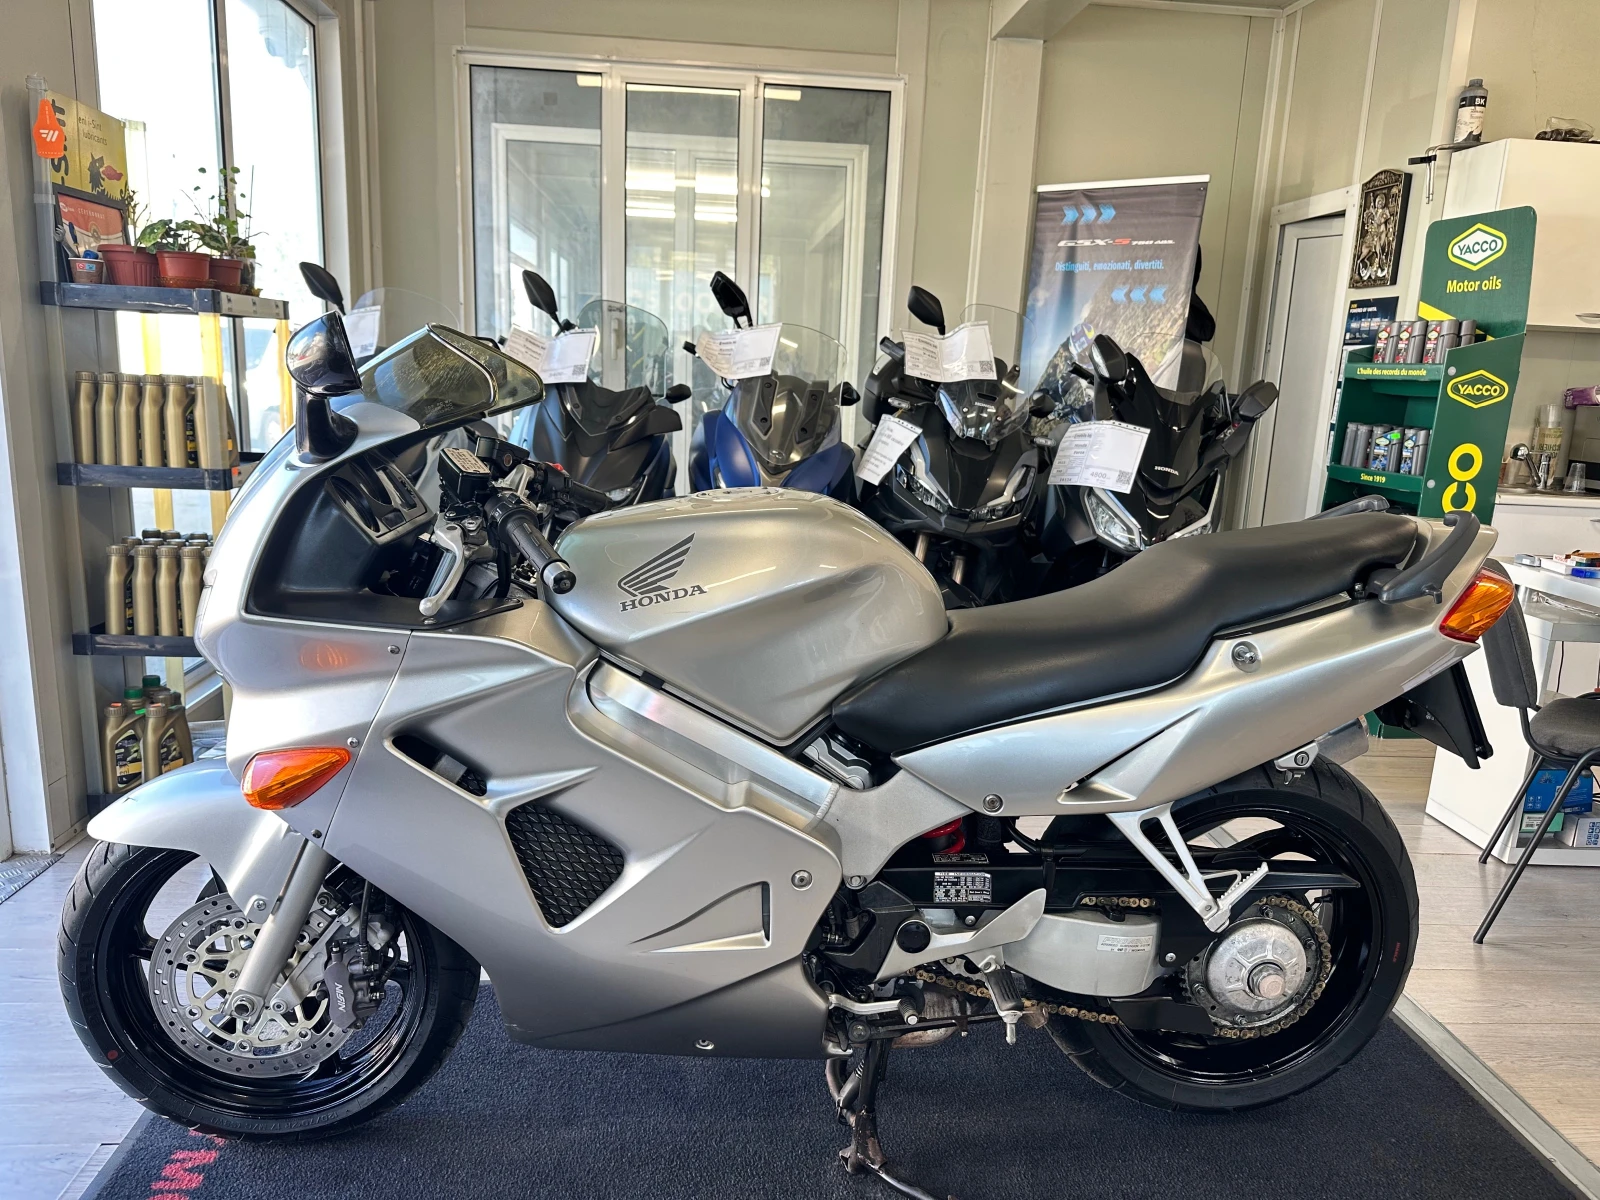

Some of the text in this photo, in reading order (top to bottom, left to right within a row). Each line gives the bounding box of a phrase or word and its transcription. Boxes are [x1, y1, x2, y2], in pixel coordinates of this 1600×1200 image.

[82, 130, 108, 146] lubricants
[1457, 239, 1498, 256] YACCO
[1055, 258, 1164, 273] Distinguiti, emozionati, divertiti.
[1446, 275, 1502, 293] Motor oils
[1356, 367, 1372, 375] L'huile
[1407, 368, 1427, 376] monde
[1457, 384, 1500, 397] YACCO
[1090, 471, 1107, 479] 4800
[1154, 465, 1179, 476] HONDA
[1360, 473, 1386, 484] Since 1919
[620, 584, 707, 612] HONDA
